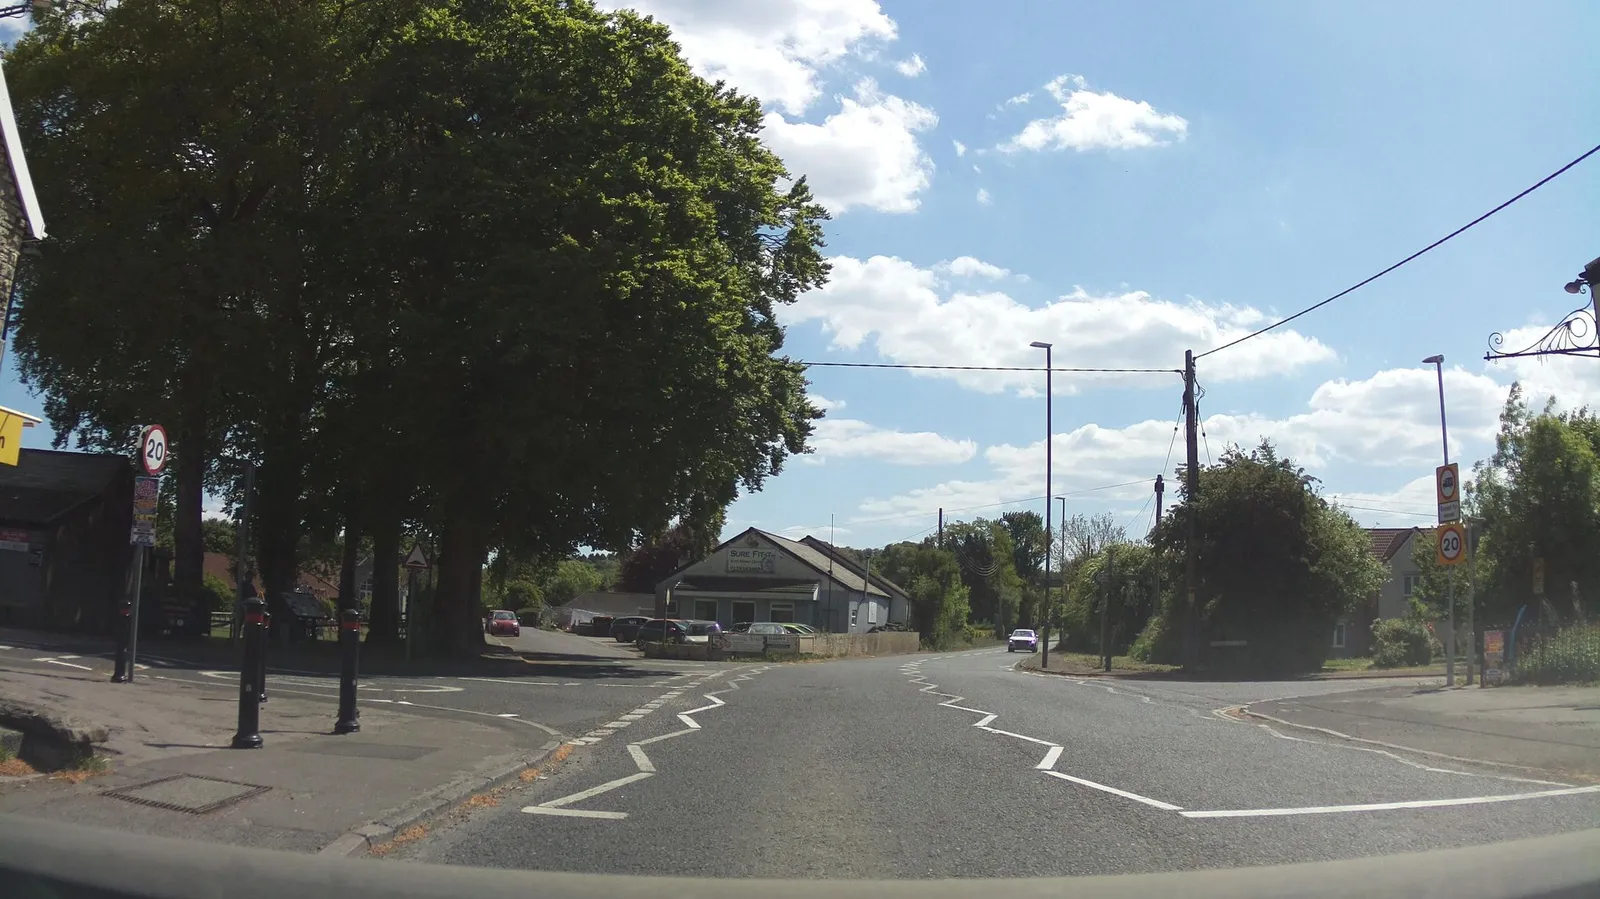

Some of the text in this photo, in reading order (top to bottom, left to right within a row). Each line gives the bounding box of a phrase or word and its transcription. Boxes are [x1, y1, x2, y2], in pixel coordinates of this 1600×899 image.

[147, 438, 164, 461] 20
[1443, 536, 1459, 552] 20
[730, 550, 751, 558] SURE
